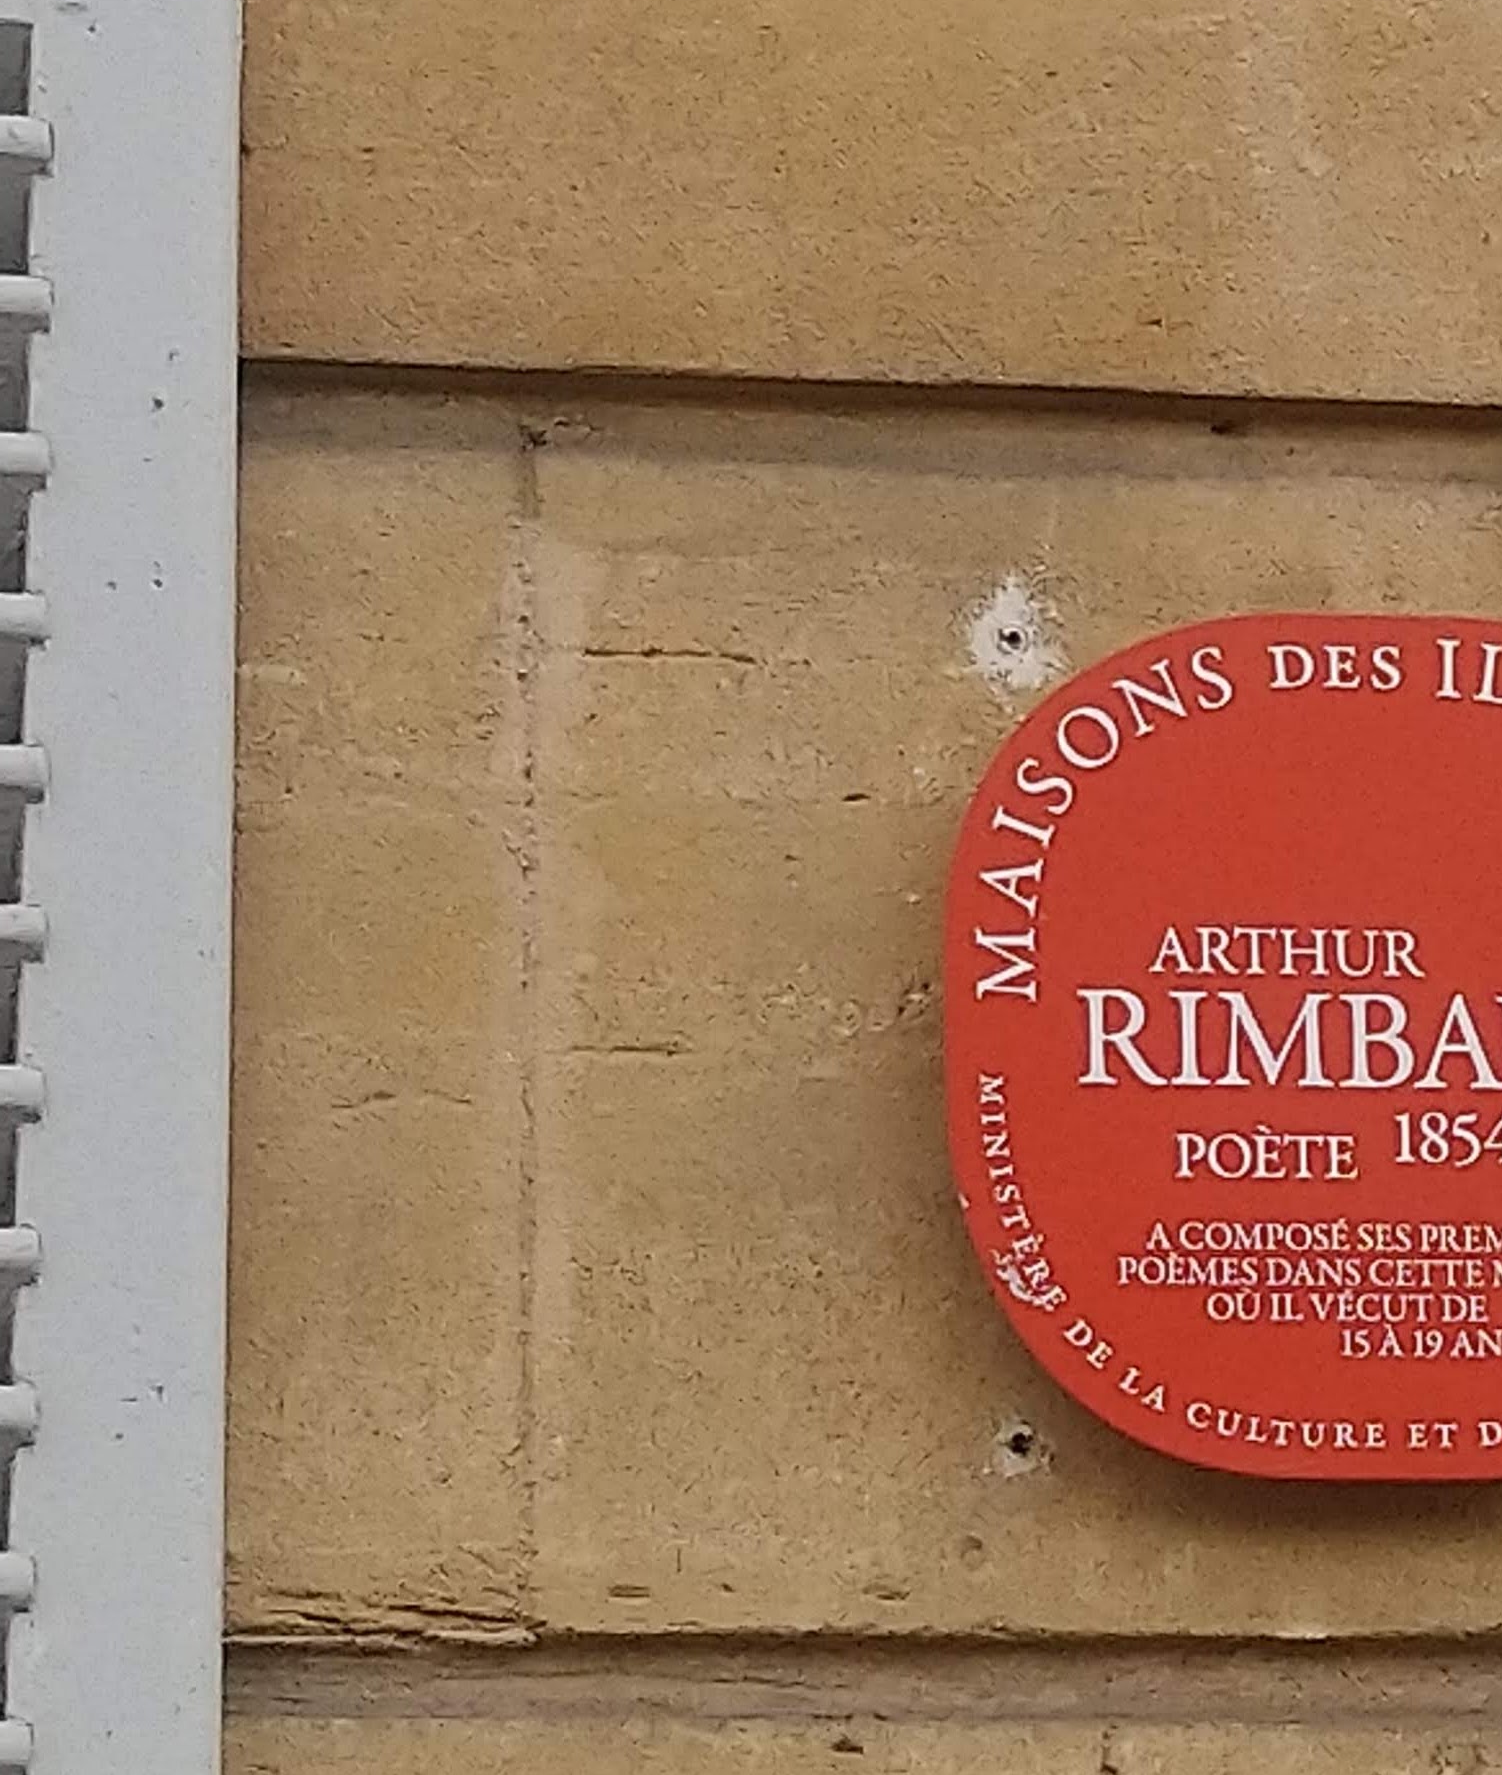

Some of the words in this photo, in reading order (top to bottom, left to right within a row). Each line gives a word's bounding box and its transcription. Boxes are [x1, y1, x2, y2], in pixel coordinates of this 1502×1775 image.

[975, 644, 1236, 1004] MAISONS
[1267, 645, 1401, 690] DES
[1148, 926, 1425, 977] ARTHUR
[1176, 1125, 1358, 1179] POÈTE
[1146, 1222, 1177, 1251] A
[1179, 1218, 1351, 1251] COMPOSÉ
[1357, 1223, 1412, 1252] SES
[979, 1073, 1068, 1312] MINISTÈRE
[1063, 1319, 1112, 1369] DE
[1119, 1367, 1164, 1411] LA
[1187, 1403, 1386, 1448] CULTURE
[1408, 1423, 1458, 1448] ET
[1119, 1251, 1258, 1286] POÈMES
[1266, 1258, 1361, 1286] DANS
[1368, 1259, 1485, 1288] CETTE
[1207, 1288, 1261, 1320] OÙ
[1270, 1293, 1304, 1321] IL
[1310, 1290, 1434, 1322] VÉCUT
[1441, 1294, 1489, 1322] DE
[1342, 1329, 1371, 1358] 15
[1378, 1324, 1403, 1356] À
[1414, 1330, 1443, 1358] 19
